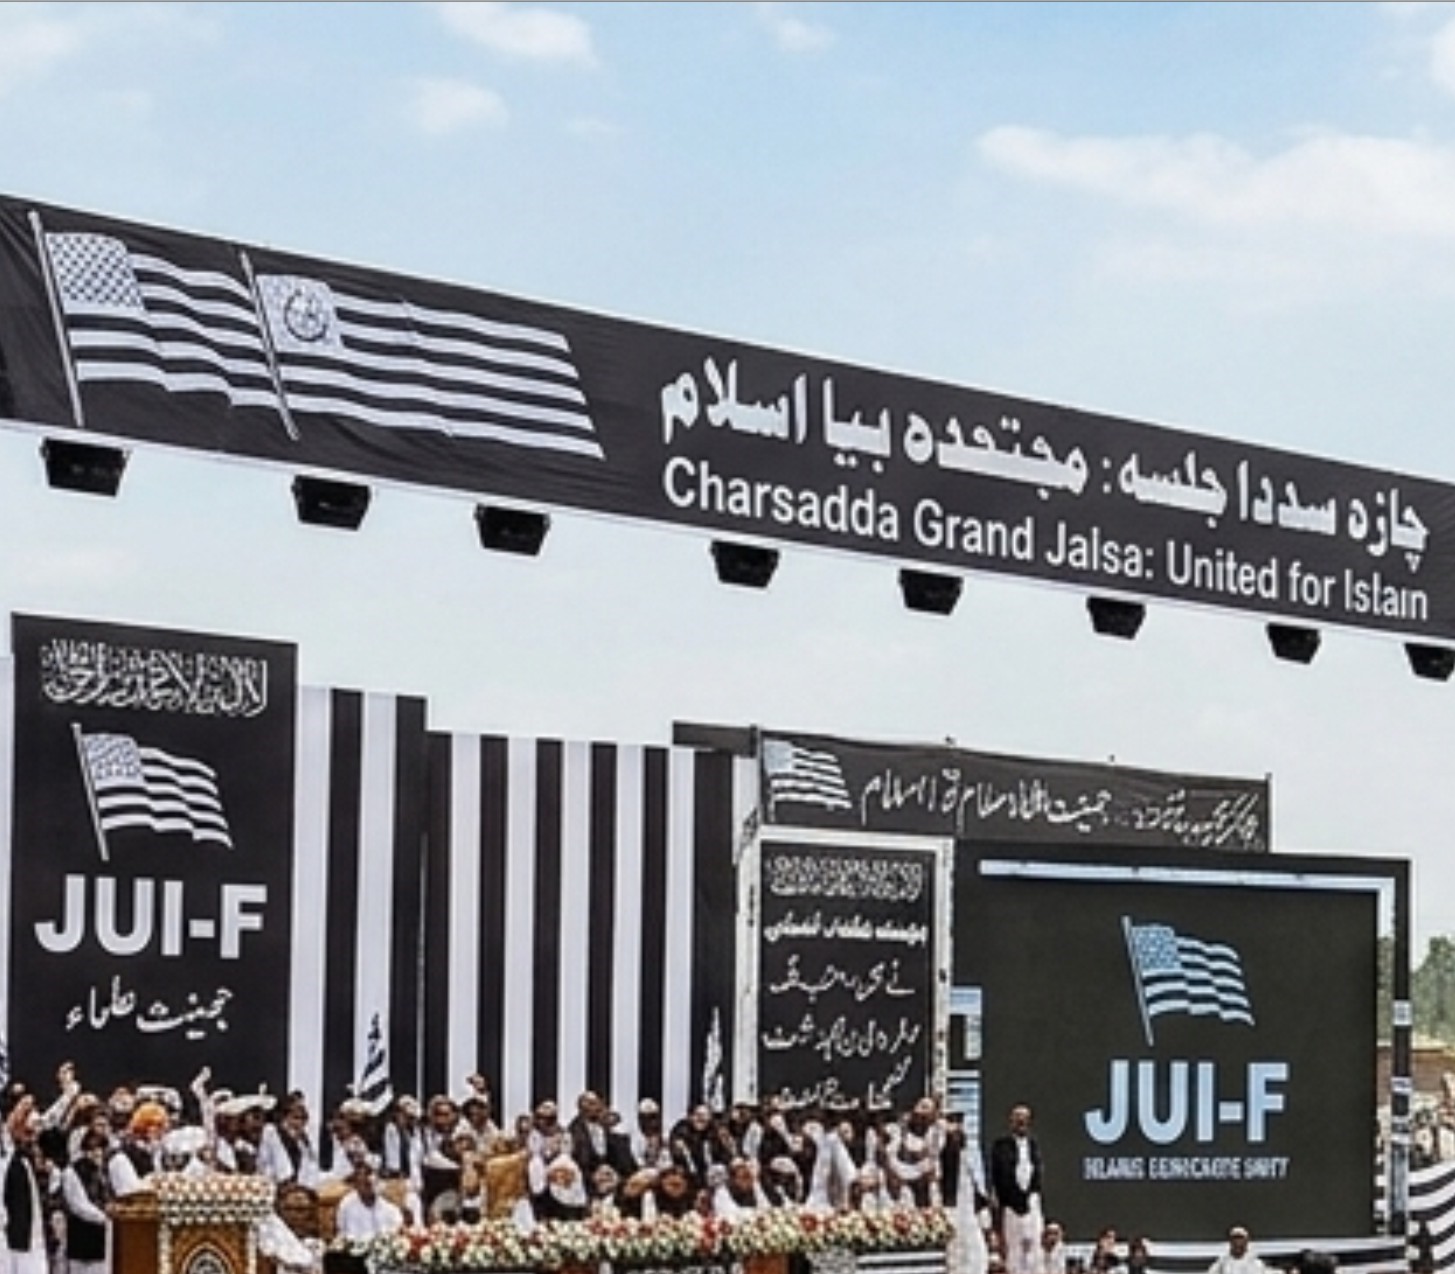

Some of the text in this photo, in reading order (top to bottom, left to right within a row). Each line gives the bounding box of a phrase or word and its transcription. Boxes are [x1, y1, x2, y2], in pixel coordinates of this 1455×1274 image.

[663, 457, 900, 541] Charsadda
[913, 498, 1035, 561] Grand
[1045, 521, 1155, 580] Jalsa:
[1166, 540, 1279, 600] United
[1288, 561, 1336, 607] for
[34, 874, 268, 959] JUI-F
[1084, 1059, 1289, 1144] JUI-F
